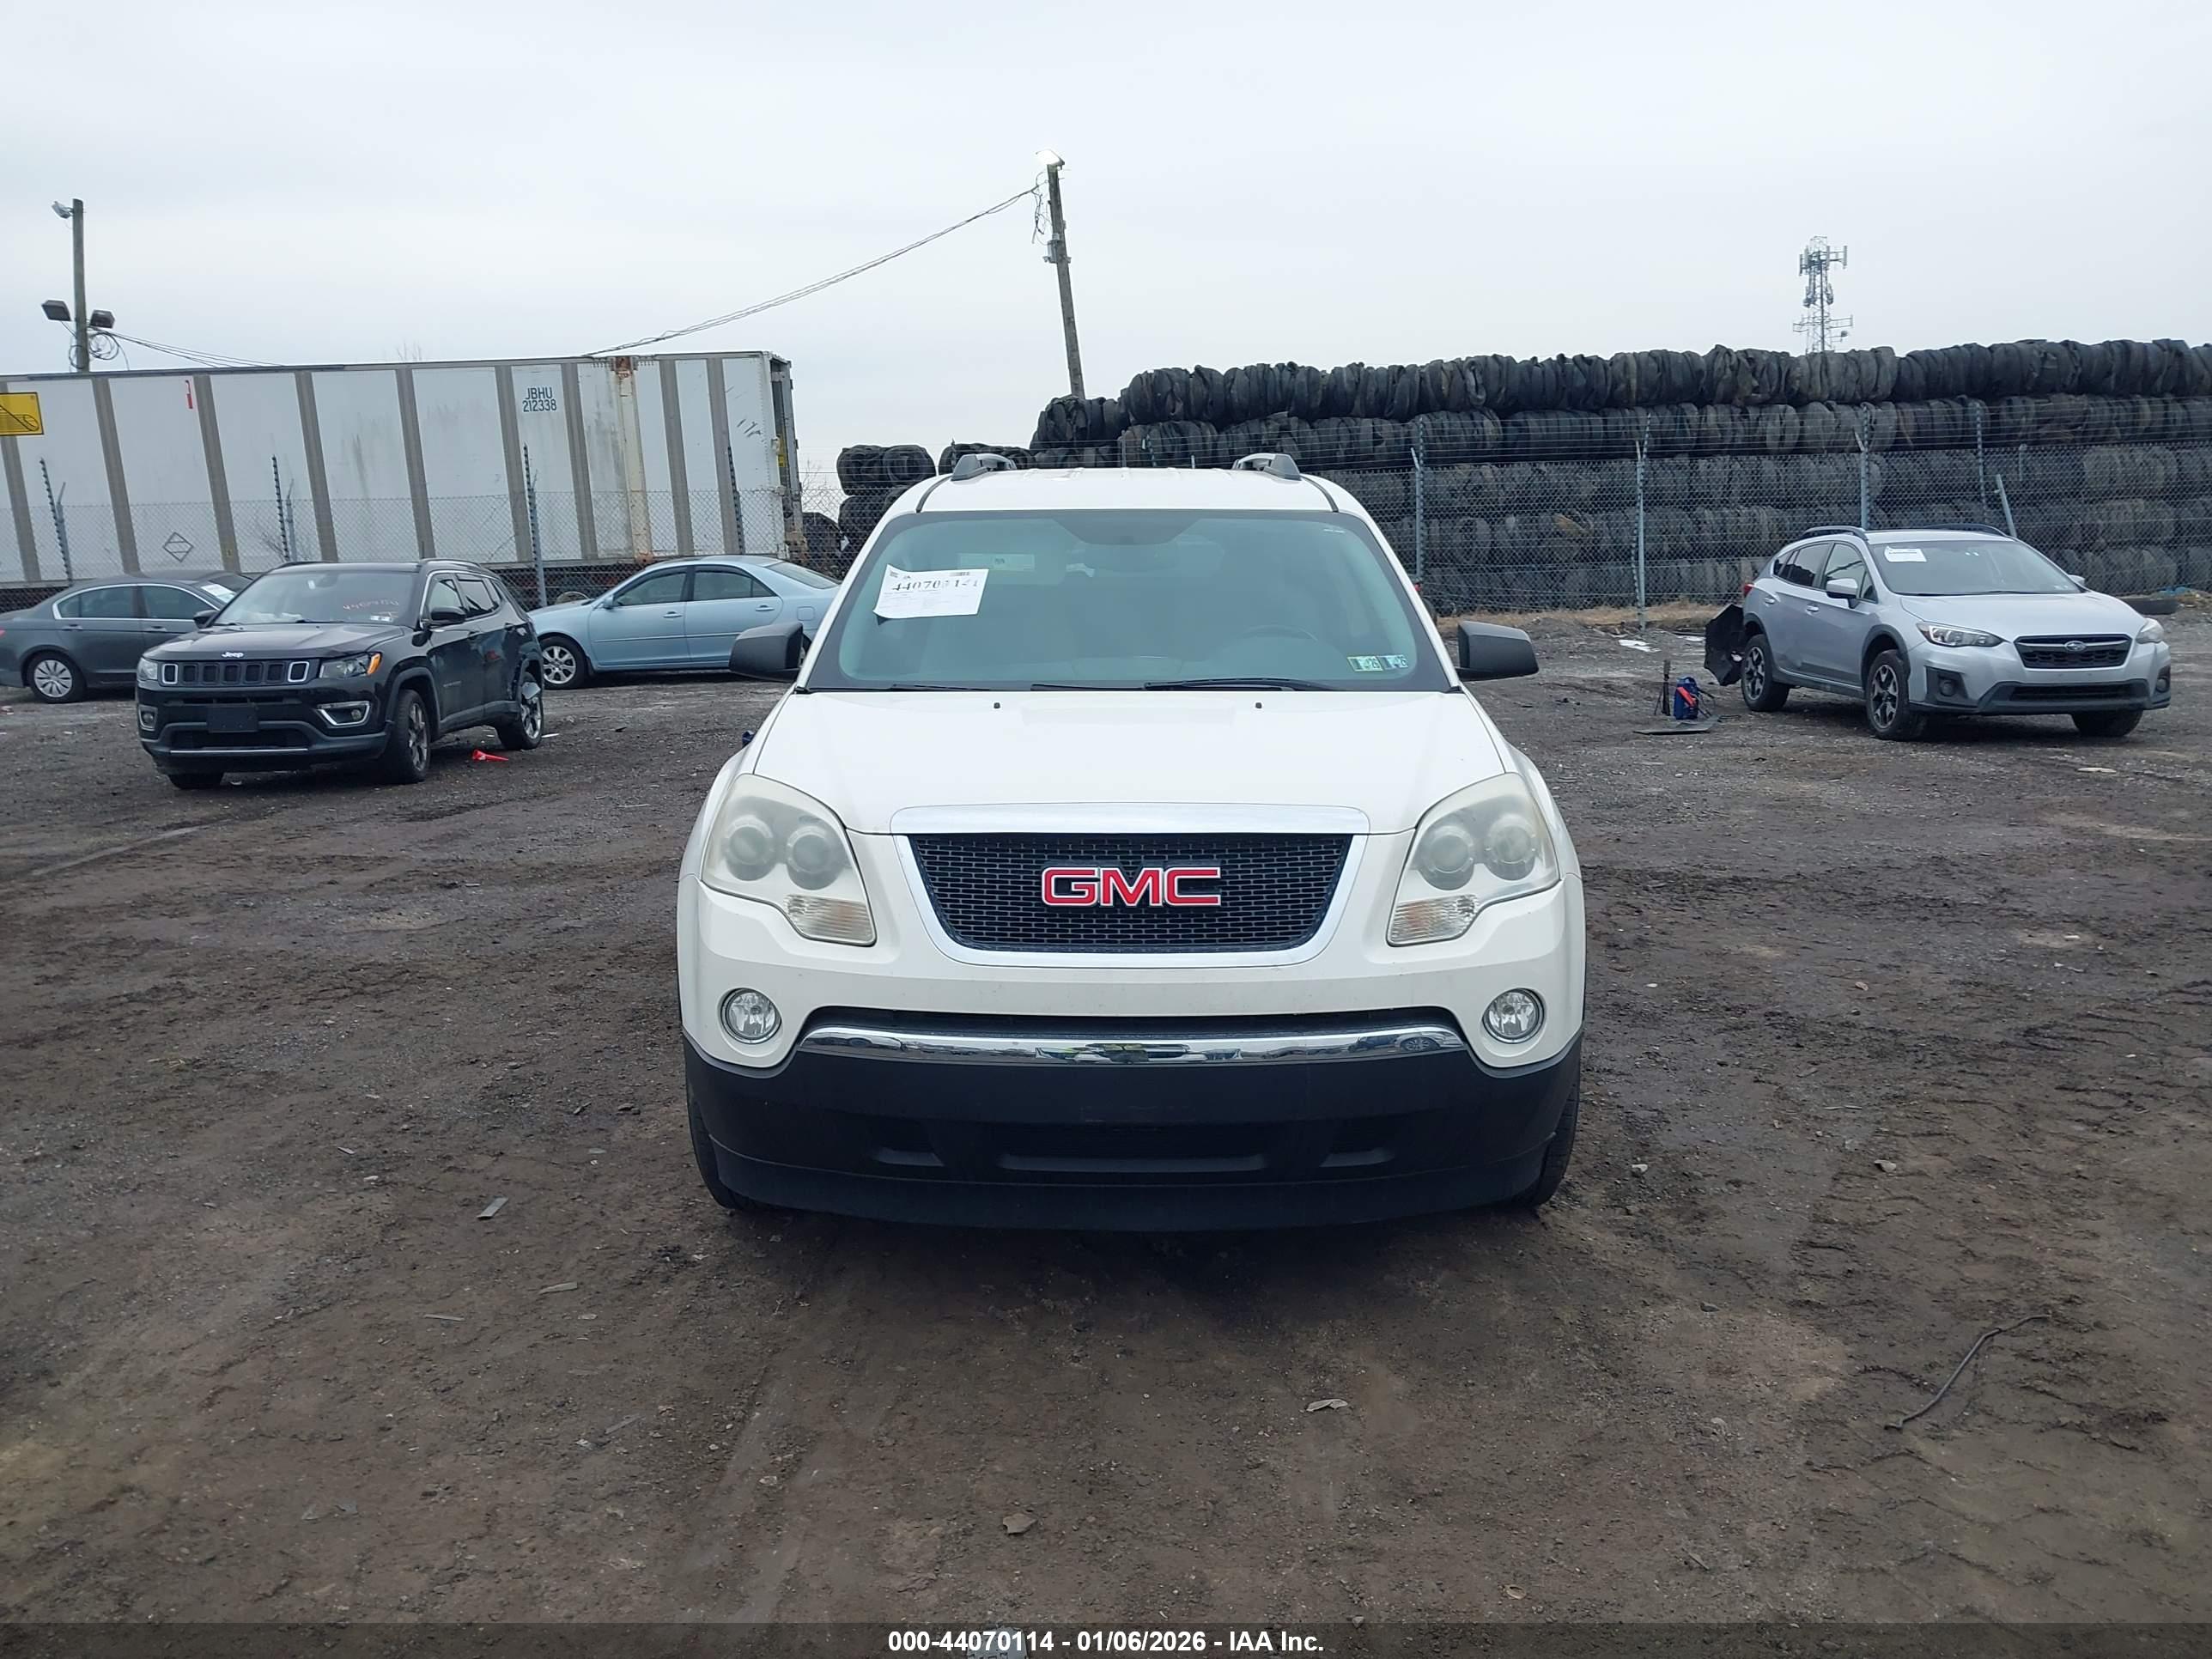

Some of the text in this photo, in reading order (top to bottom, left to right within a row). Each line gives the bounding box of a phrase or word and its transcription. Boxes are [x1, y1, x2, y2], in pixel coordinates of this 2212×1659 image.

[526, 387, 552, 399] JBHU
[523, 399, 556, 412] 212338
[1042, 866, 1222, 907] GMC
